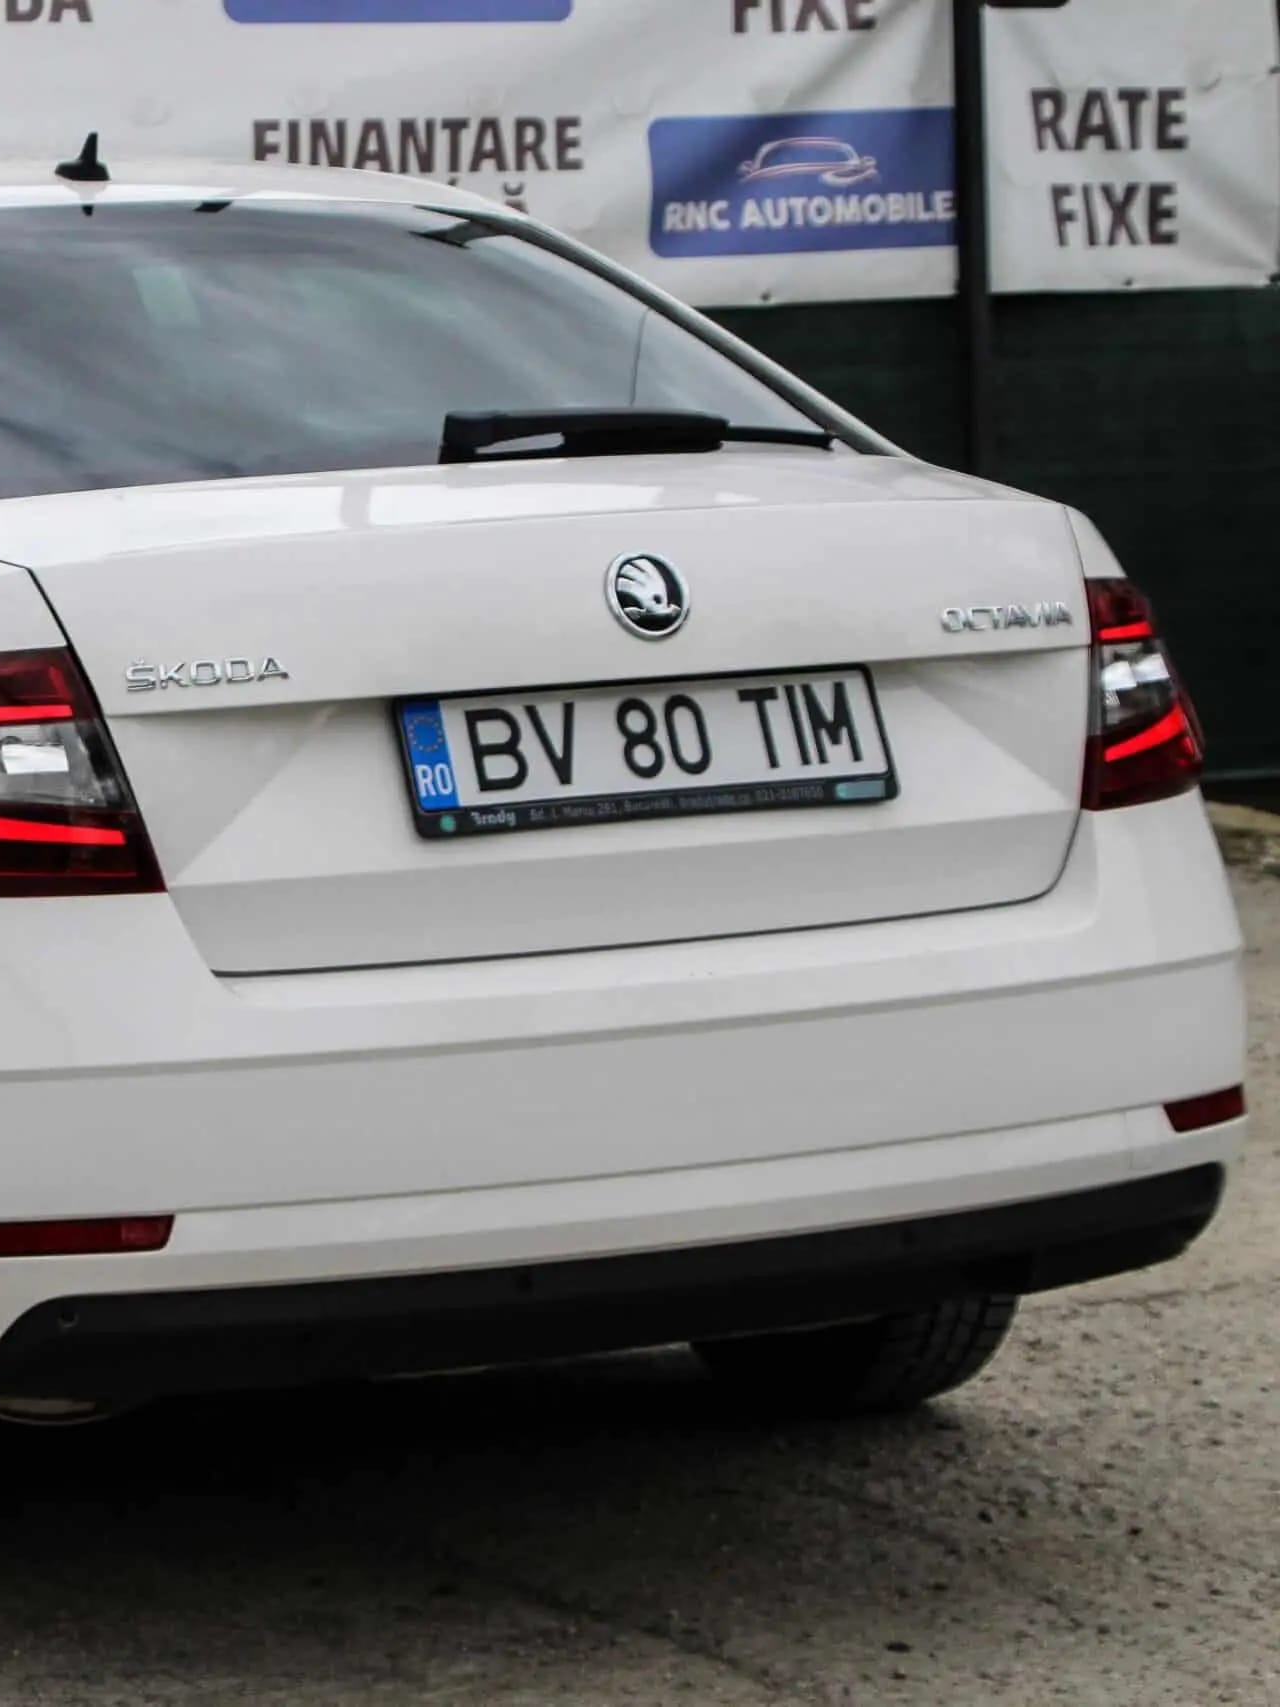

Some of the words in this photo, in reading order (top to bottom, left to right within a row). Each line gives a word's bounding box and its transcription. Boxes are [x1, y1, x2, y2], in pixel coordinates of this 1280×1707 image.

[1030, 87, 1188, 151] RATE
[662, 200, 731, 232] RNC
[740, 191, 957, 228] AUTOMOBILE
[1051, 182, 1179, 247] FIXE
[941, 600, 1073, 633] OCTAVIA
[125, 656, 290, 692] ŠKODA
[464, 702, 575, 792] BV
[616, 694, 712, 779] 80
[737, 681, 862, 768] TIM
[415, 763, 454, 797] RO
